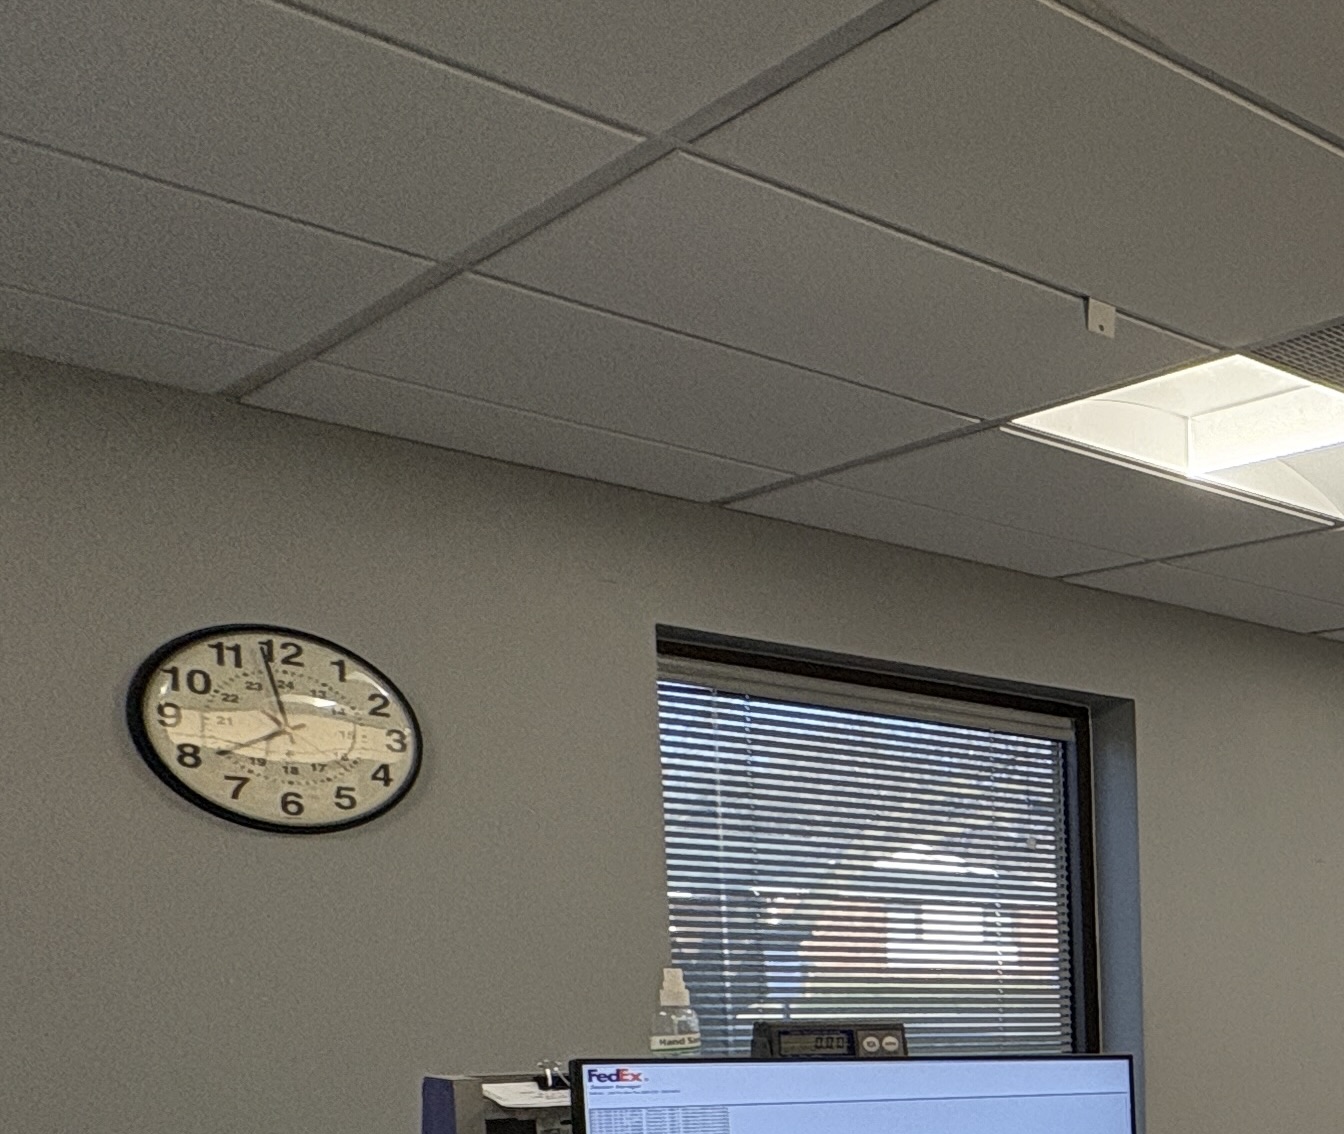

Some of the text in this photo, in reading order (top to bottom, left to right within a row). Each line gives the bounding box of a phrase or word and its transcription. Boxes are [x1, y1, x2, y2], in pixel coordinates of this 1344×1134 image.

[208, 642, 243, 668] 11
[259, 640, 305, 666] 12
[162, 666, 211, 695] 10
[331, 659, 347, 682] 1
[222, 694, 239, 703] 22
[367, 694, 390, 717] 2
[157, 703, 181, 728] 9
[385, 729, 407, 753] 3
[177, 744, 202, 768] 8
[311, 764, 326, 772] 17
[371, 764, 393, 786] 4
[224, 776, 250, 799] 7
[335, 786, 356, 810] 5
[281, 792, 304, 815] 6
[659, 1036, 685, 1046] Hand
[588, 1069, 642, 1082] FedEx
